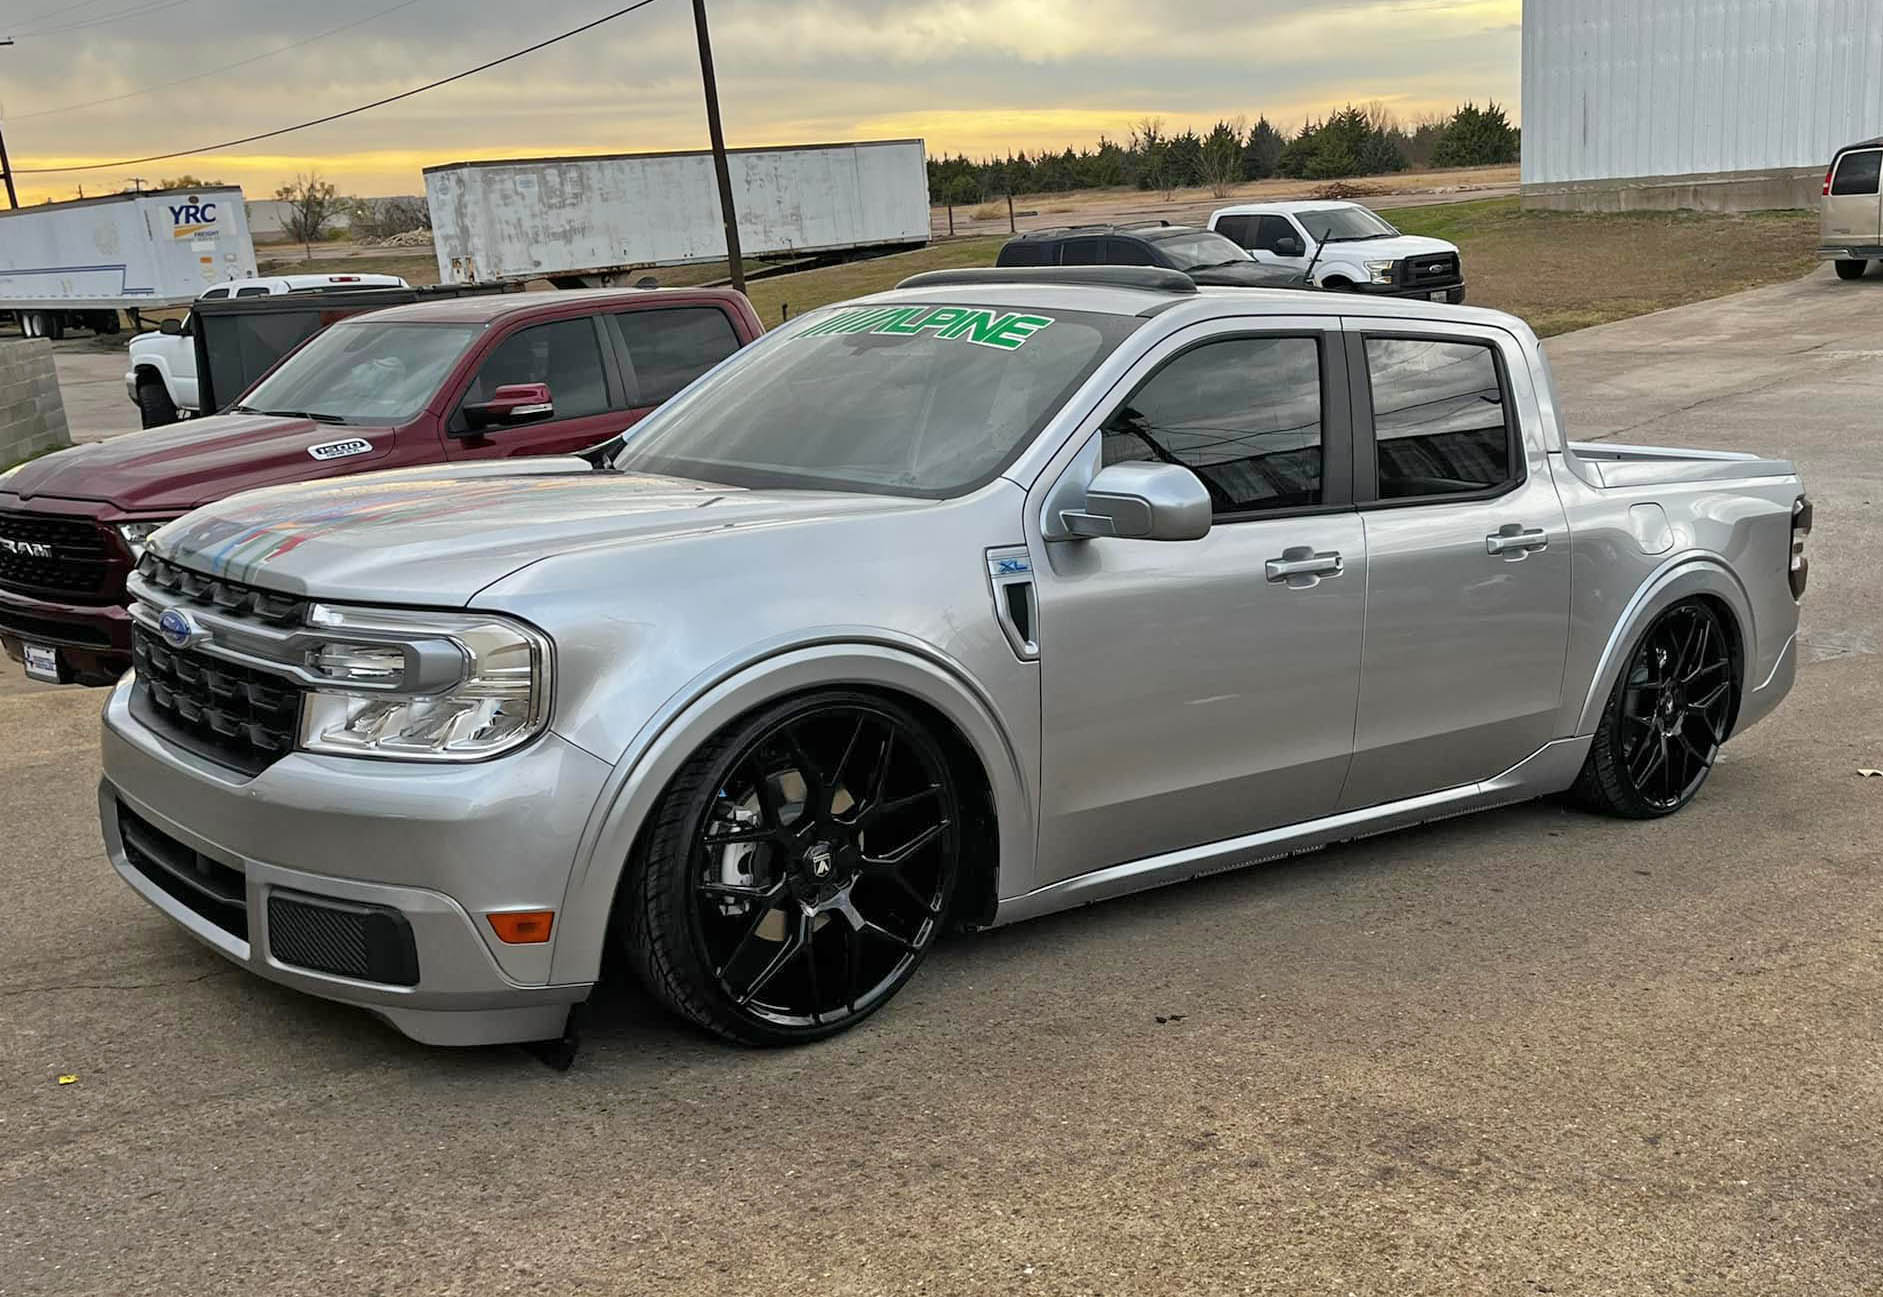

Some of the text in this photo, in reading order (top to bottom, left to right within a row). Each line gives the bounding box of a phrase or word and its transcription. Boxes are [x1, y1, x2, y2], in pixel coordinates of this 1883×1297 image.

[168, 203, 217, 225] YRC
[840, 306, 1055, 350] ALPINE
[317, 441, 365, 454] 1500
[0, 537, 52, 558] RAM
[998, 559, 1028, 573] XL
